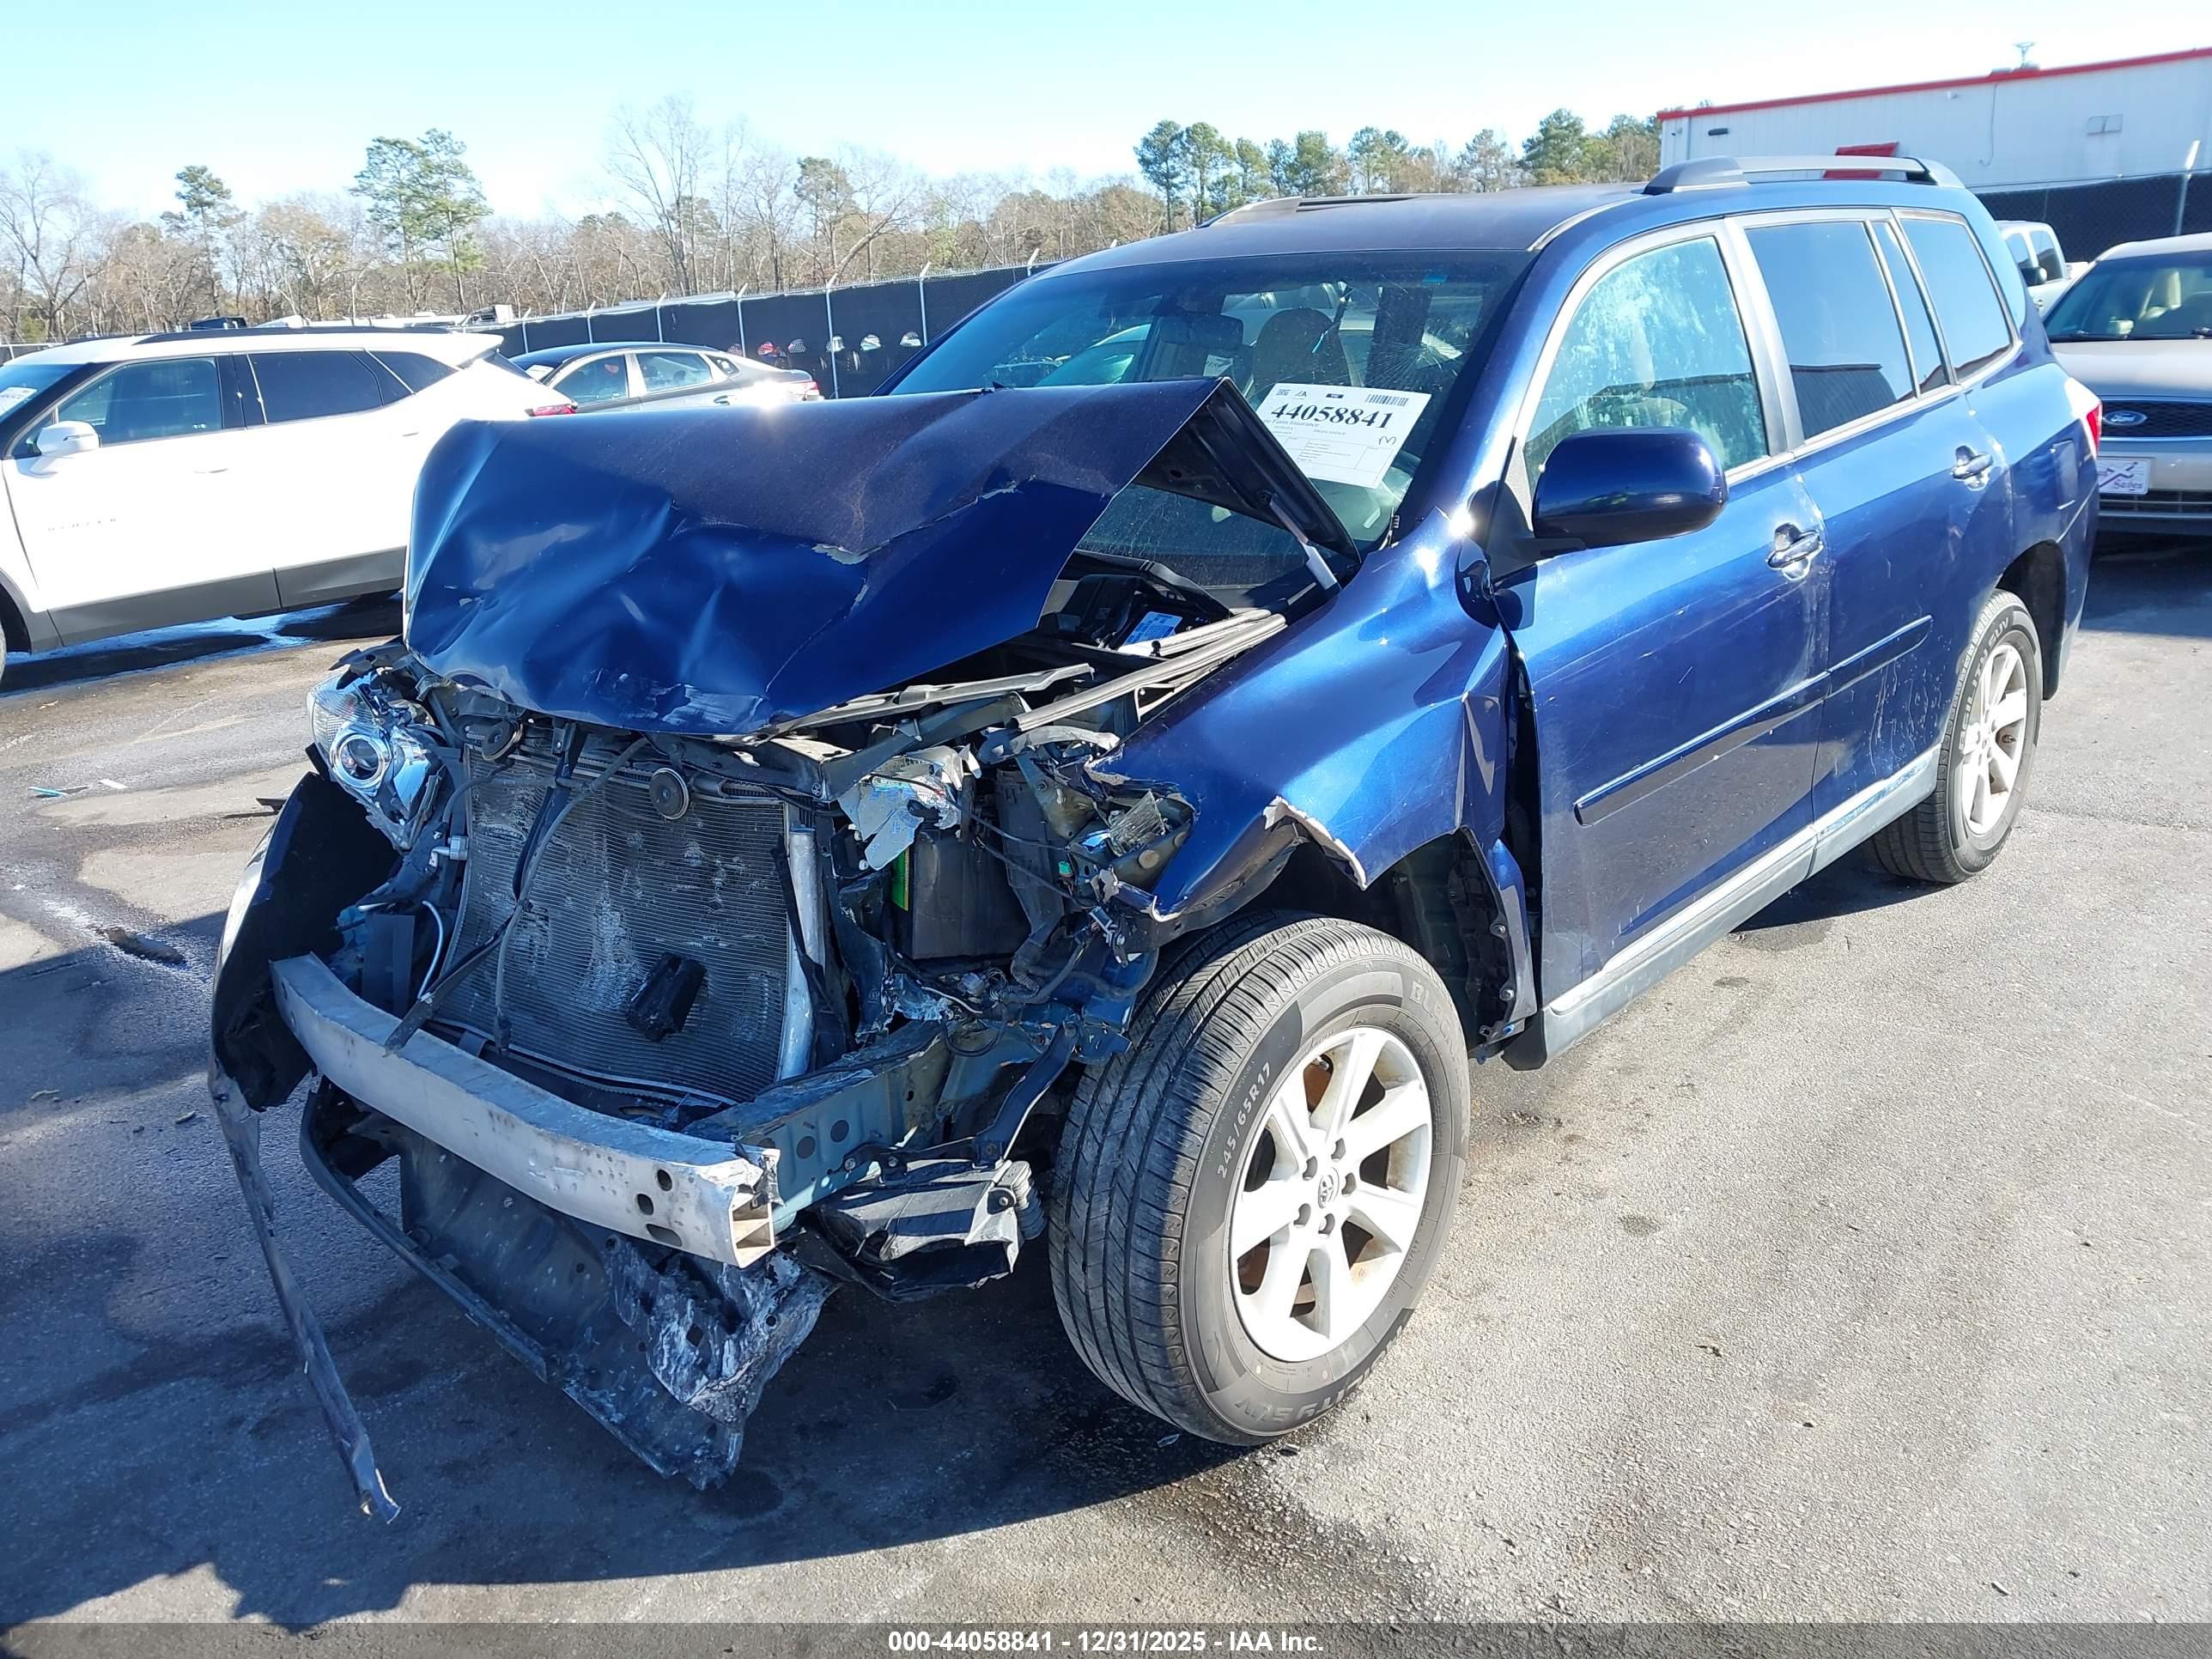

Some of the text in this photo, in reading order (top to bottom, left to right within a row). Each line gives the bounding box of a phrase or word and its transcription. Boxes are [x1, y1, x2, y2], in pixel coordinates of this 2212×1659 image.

[1271, 404, 1394, 428] 44058841
[1290, 419, 1320, 428] Insurance
[1989, 617, 2010, 647] SUV
[1217, 1061, 1271, 1178] 245/65R17
